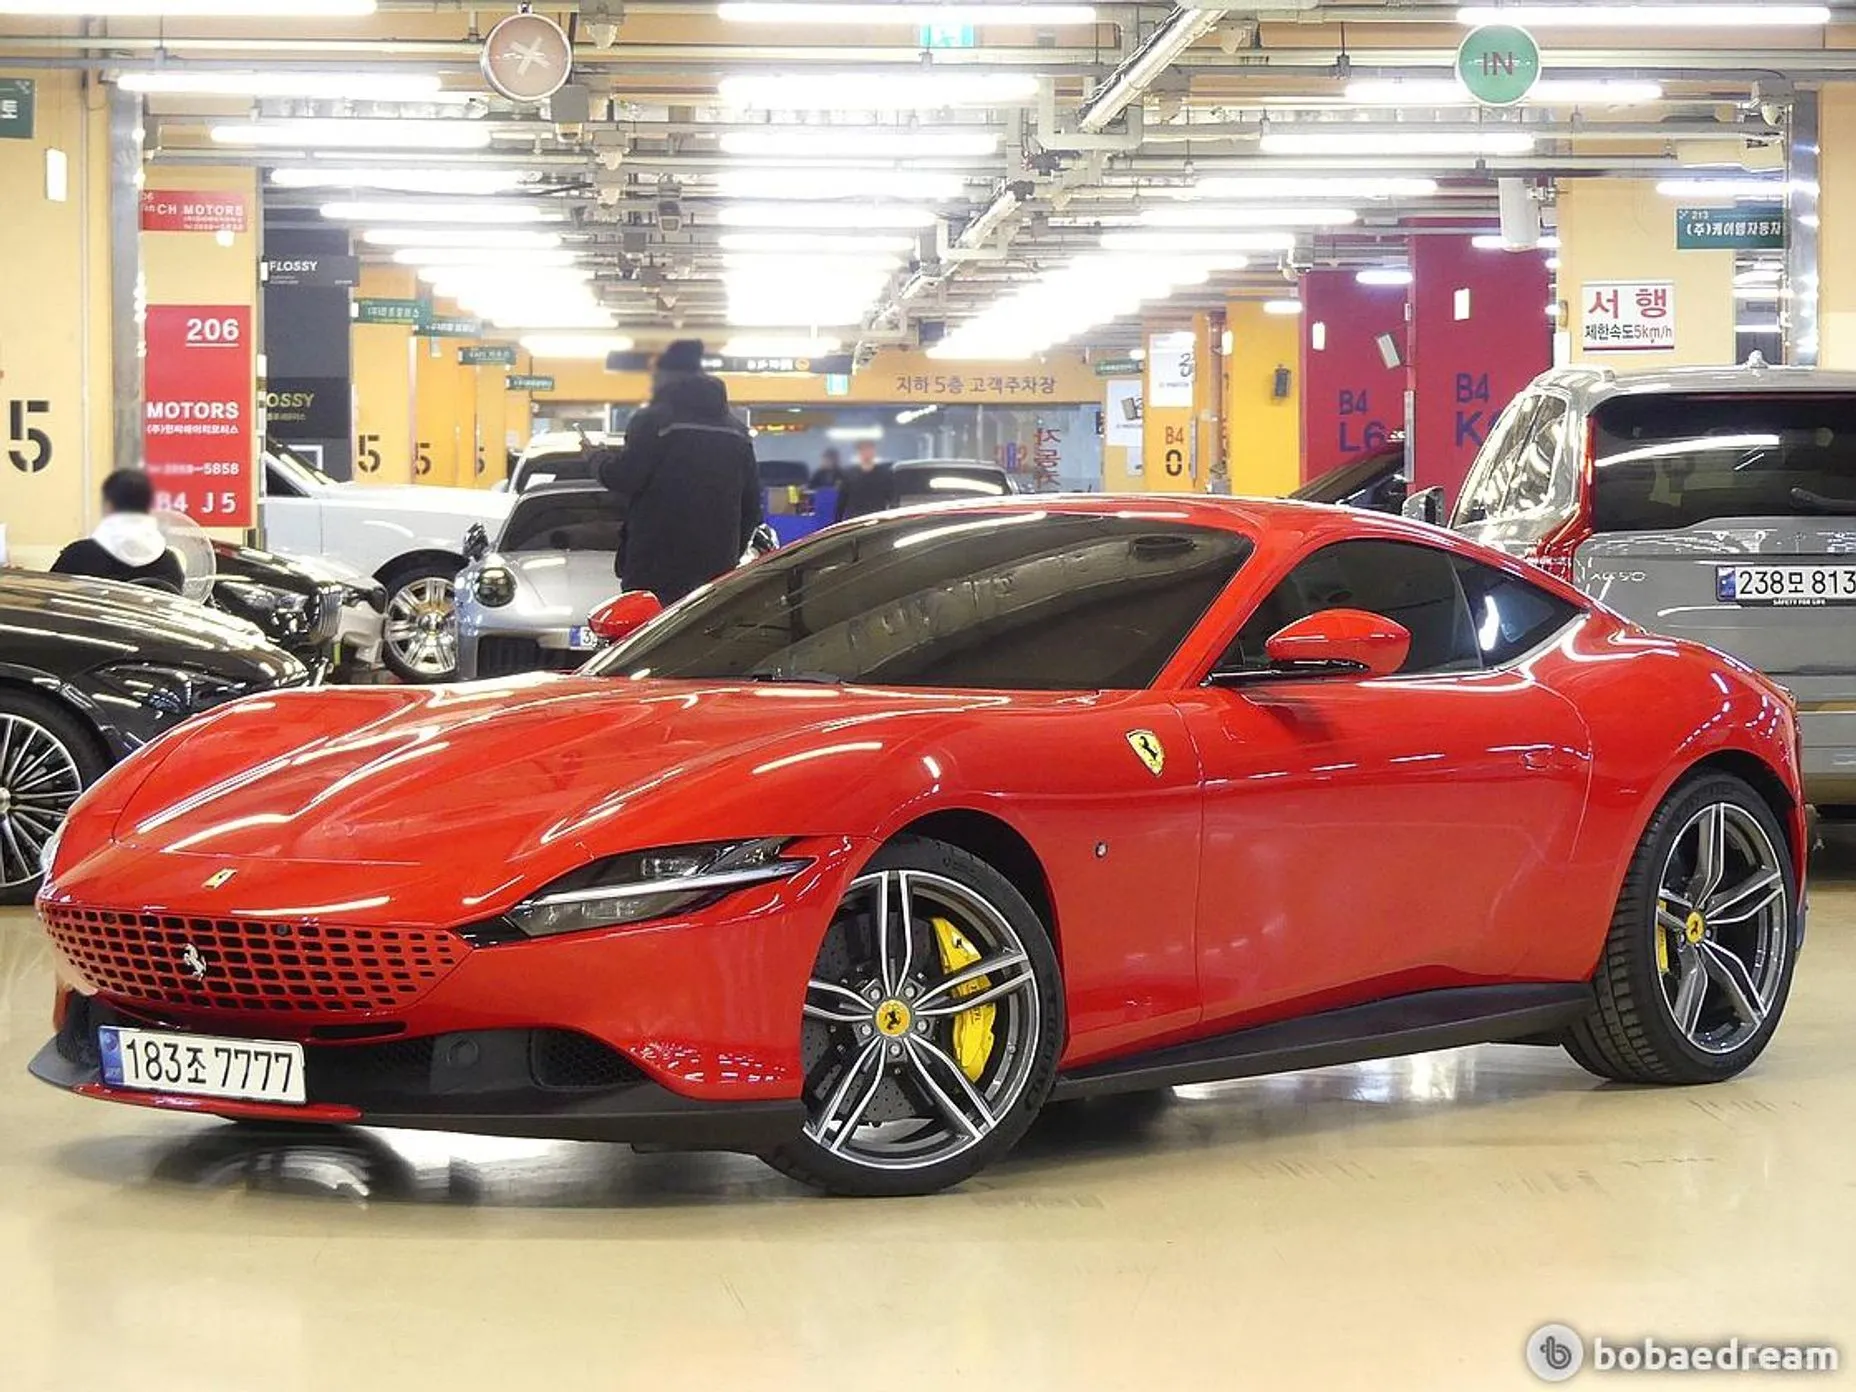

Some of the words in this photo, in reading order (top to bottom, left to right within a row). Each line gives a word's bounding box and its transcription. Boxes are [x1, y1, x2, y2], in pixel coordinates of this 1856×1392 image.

[1483, 51, 1513, 76] IN
[183, 204, 243, 216] MOTORS
[269, 260, 318, 272] FLOSSY
[1588, 289, 1619, 319] 서
[1635, 288, 1667, 318] 행
[186, 318, 240, 342] 206
[896, 376, 929, 394] 지하
[935, 376, 965, 394] 5층
[969, 376, 1057, 394] 고객주차장
[1456, 373, 1491, 403] B4
[147, 402, 240, 419] MOTORS
[1339, 389, 1368, 415] B4
[9, 400, 53, 473] 5
[1165, 426, 1184, 445] B4
[1456, 411, 1500, 448] K
[358, 434, 381, 473] 5
[1740, 570, 1804, 595] 238모
[126, 1038, 206, 1084] 183조
[214, 1047, 293, 1093] 7777
